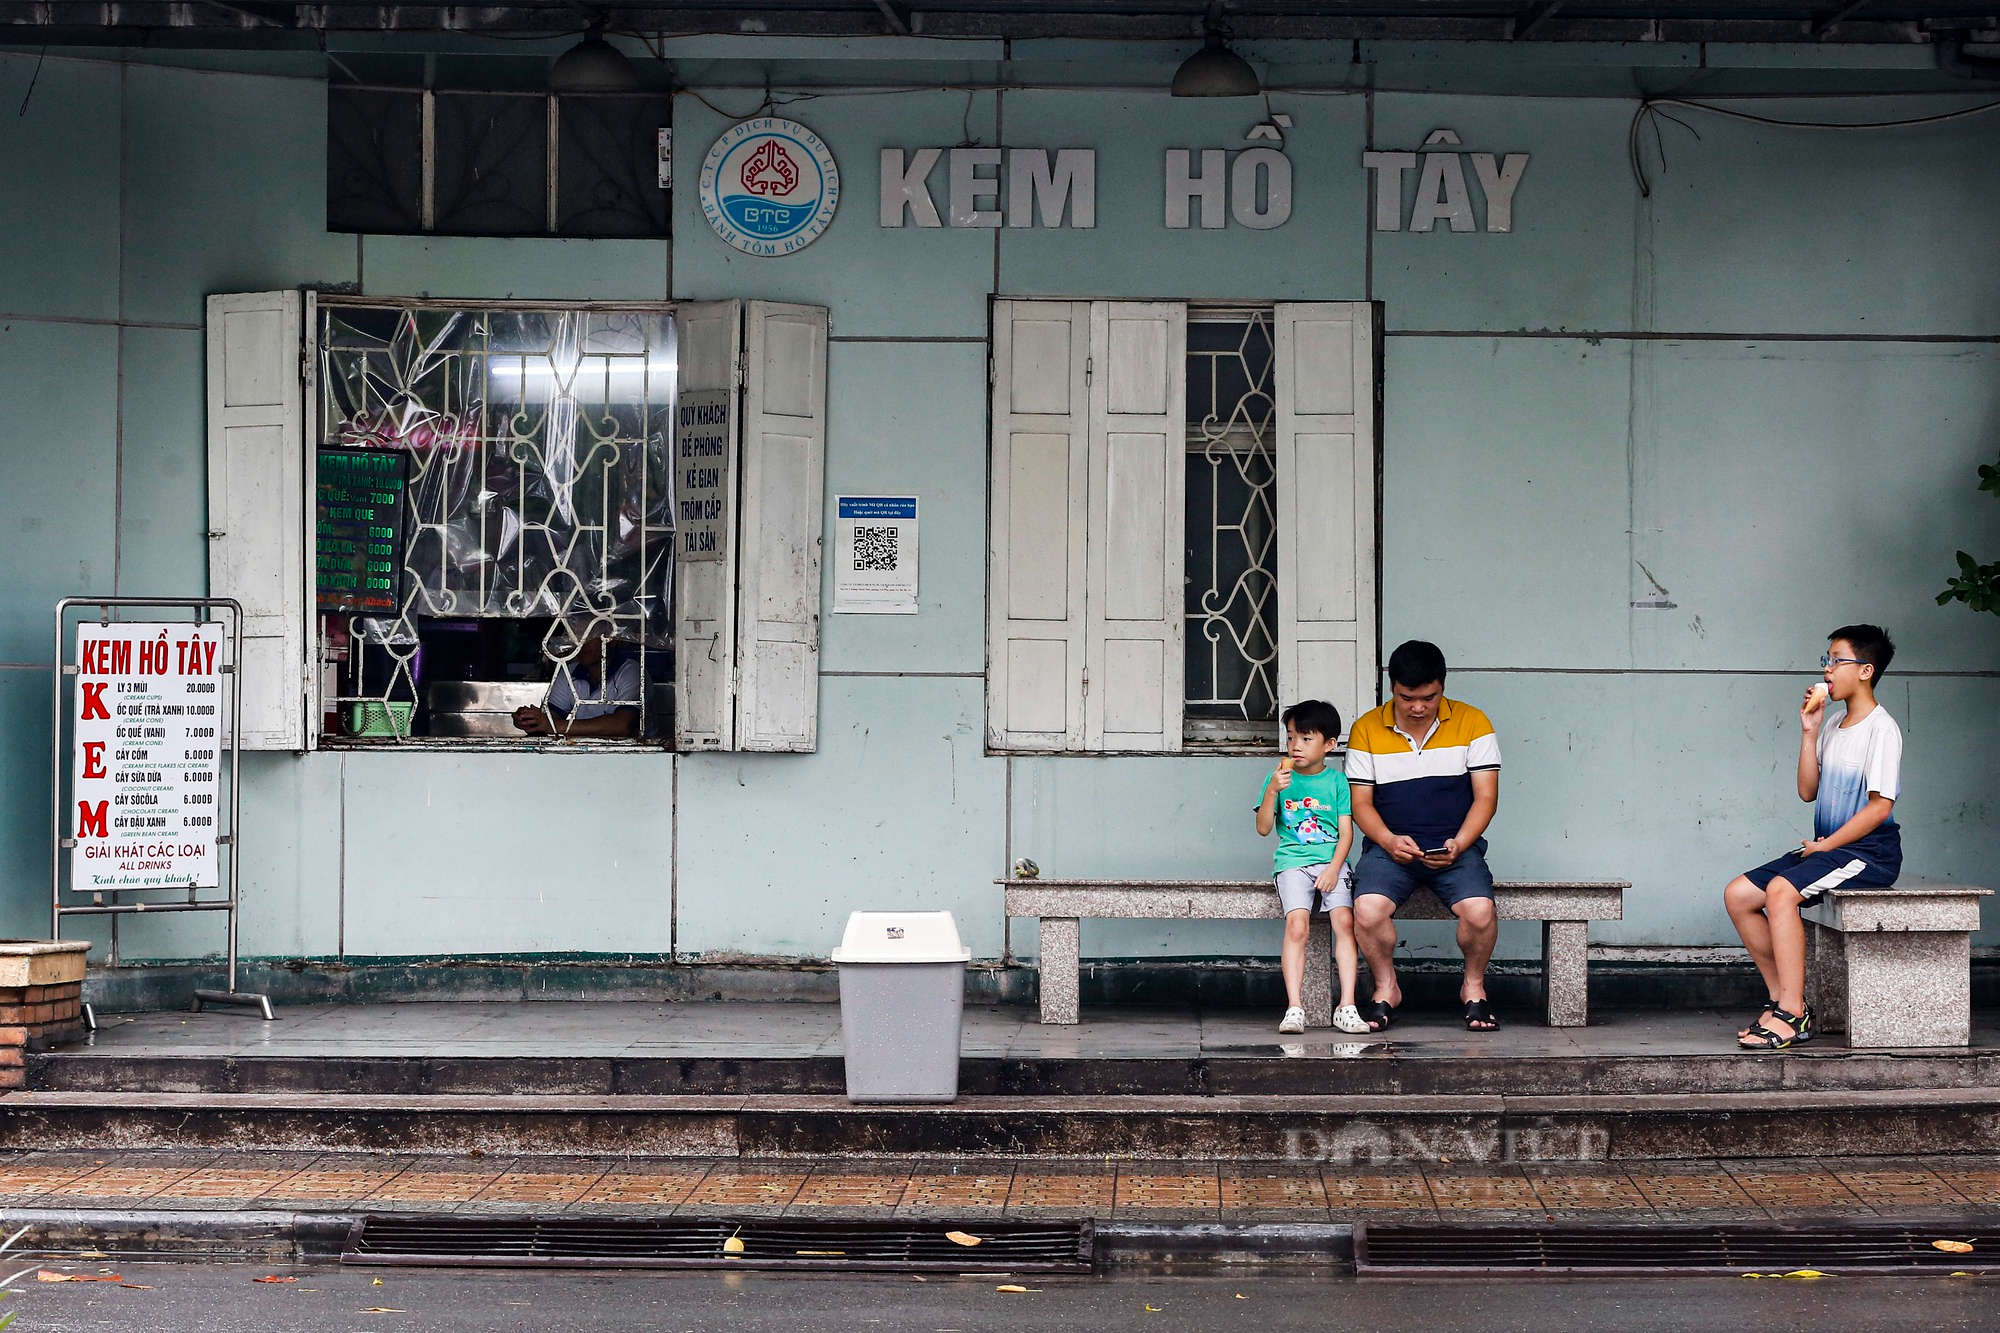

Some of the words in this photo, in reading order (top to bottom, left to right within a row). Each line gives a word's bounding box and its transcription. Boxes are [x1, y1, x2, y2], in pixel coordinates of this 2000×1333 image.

[807, 135, 825, 153] DU
[880, 148, 1095, 229] KEM
[1165, 114, 1294, 230] HỒ
[1363, 129, 1530, 233] TÂY
[757, 224, 779, 233] 1956
[742, 240, 775, 254] TÔM
[680, 402, 696, 428] QUÝ
[698, 401, 726, 426] KHÁCH
[694, 432, 722, 457] PHÒNG
[320, 455, 348, 469] KEM
[372, 455, 396, 472] TÂY
[686, 462, 696, 489] KẺ
[698, 468, 718, 488] GIAN
[370, 492, 394, 504] 7000
[330, 507, 352, 518] KEM
[354, 508, 374, 520] QUE
[681, 496, 702, 524] TRỘM
[368, 526, 393, 538] 6000
[684, 528, 696, 552] TÀI
[700, 525, 716, 552] SẢN
[368, 544, 392, 556] 6000
[367, 561, 392, 572] 6000
[366, 578, 391, 590] 6000
[82, 640, 132, 675] KEM
[139, 628, 169, 676] HỒ
[176, 633, 217, 676] TÂY
[118, 683, 126, 693] LY
[127, 683, 132, 693] 3
[134, 680, 148, 693] MÙI
[186, 683, 215, 693] 20.000Đ
[117, 702, 126, 716] ỐC
[128, 702, 143, 716] QUẾ
[144, 703, 160, 716] (TRÀ
[162, 705, 184, 716] XANH)
[186, 705, 215, 715] 10.000Đ
[116, 724, 126, 738] ỐC
[128, 724, 142, 738] QUẾ
[144, 728, 166, 738] (VANI)
[186, 728, 214, 738] 7.000Đ
[116, 748, 130, 760] CÂY
[131, 746, 148, 760] CỐM
[184, 750, 213, 760] 6.000Đ
[115, 770, 129, 783] CÂY
[131, 770, 146, 783] SỮA
[147, 770, 162, 782] DỪA
[184, 772, 213, 782] 6.000Đ
[115, 793, 129, 805] CÂY
[130, 792, 158, 805] SÔCÔLA
[183, 794, 212, 804] 6.000Đ
[114, 816, 128, 828] CÂY
[130, 815, 145, 830] ĐẬU
[147, 817, 166, 827] XANH
[183, 816, 212, 827] 6.000Đ
[85, 841, 111, 859] GIẢI
[114, 841, 144, 858] KHÁT
[147, 841, 174, 858] CÁC
[178, 844, 206, 860] LOẠI
[119, 861, 135, 871] ALL
[138, 860, 172, 870] DRINKS
